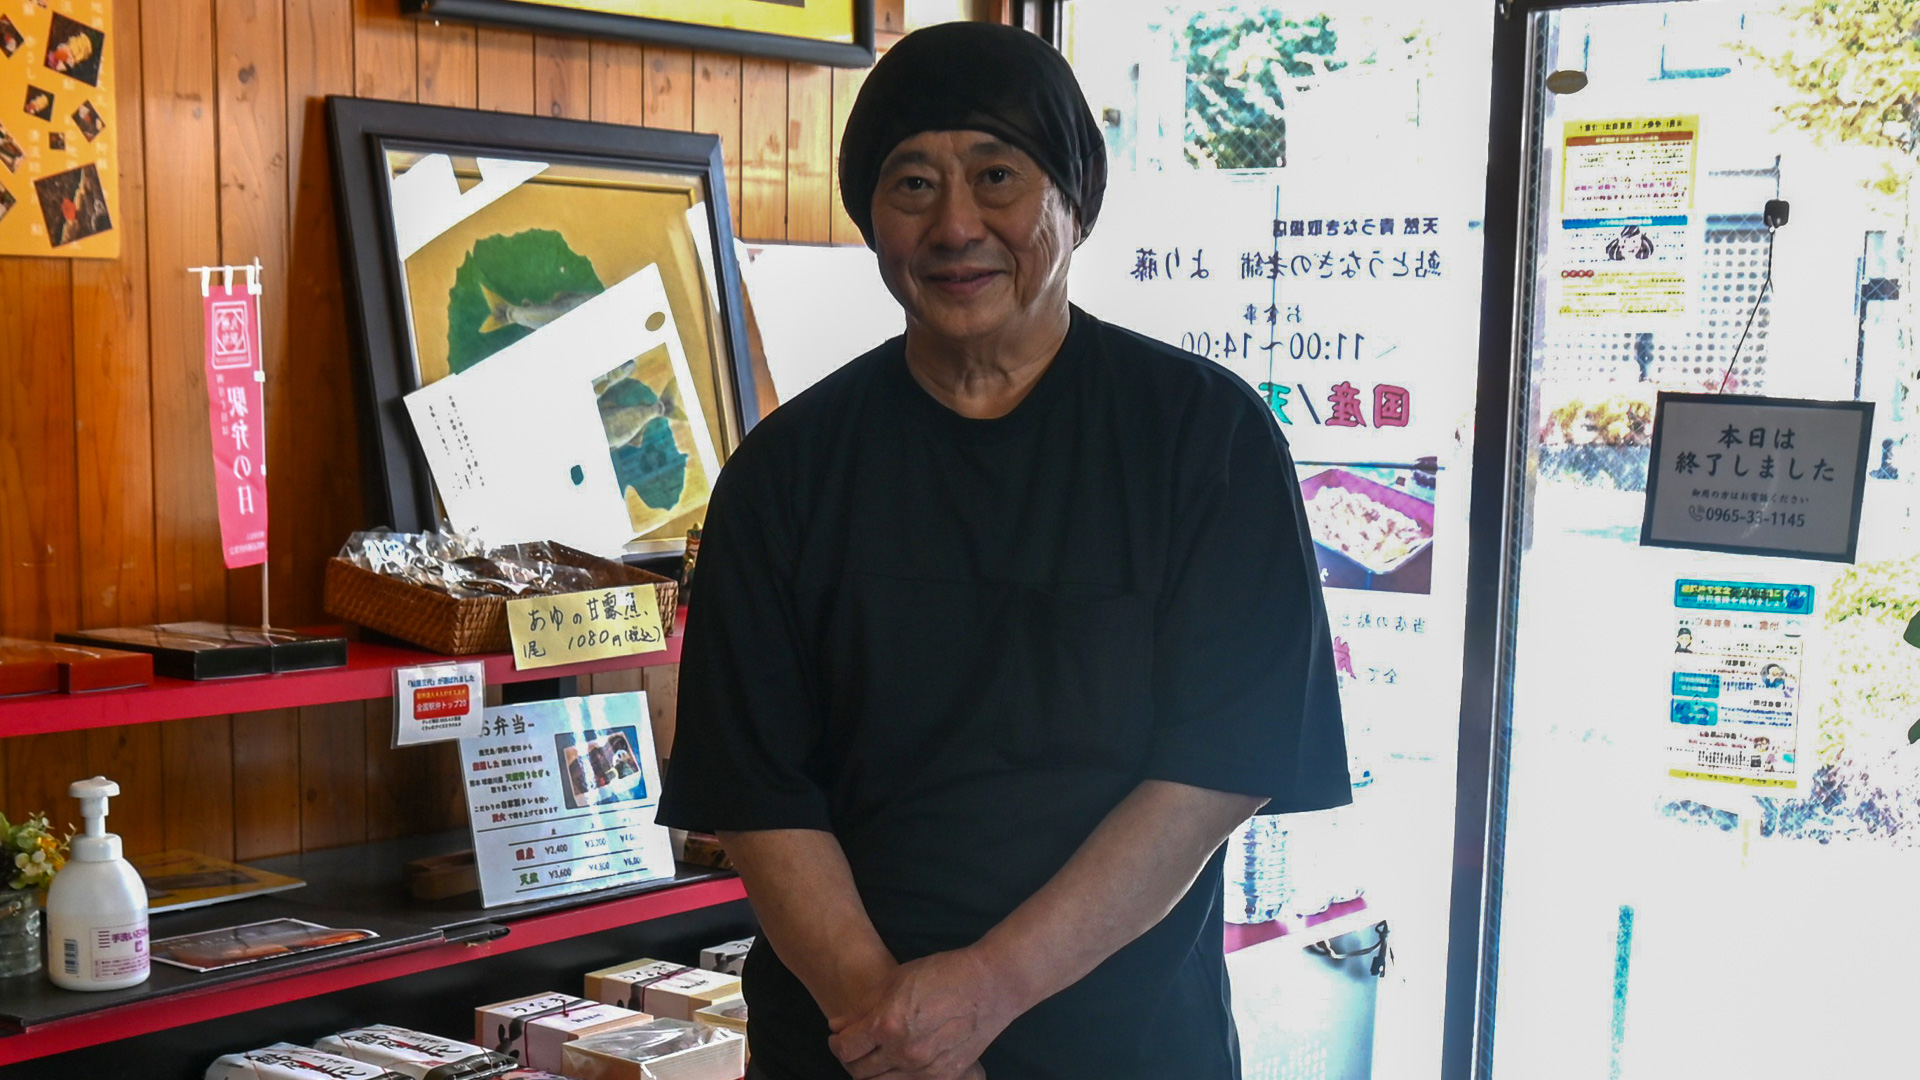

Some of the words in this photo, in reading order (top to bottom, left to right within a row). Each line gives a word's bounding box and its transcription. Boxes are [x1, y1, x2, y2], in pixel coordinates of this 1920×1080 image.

[1718, 423, 1796, 449] 本日は
[1675, 451, 1835, 482] 終了しました
[1706, 508, 1806, 527] 0965-33-1145
